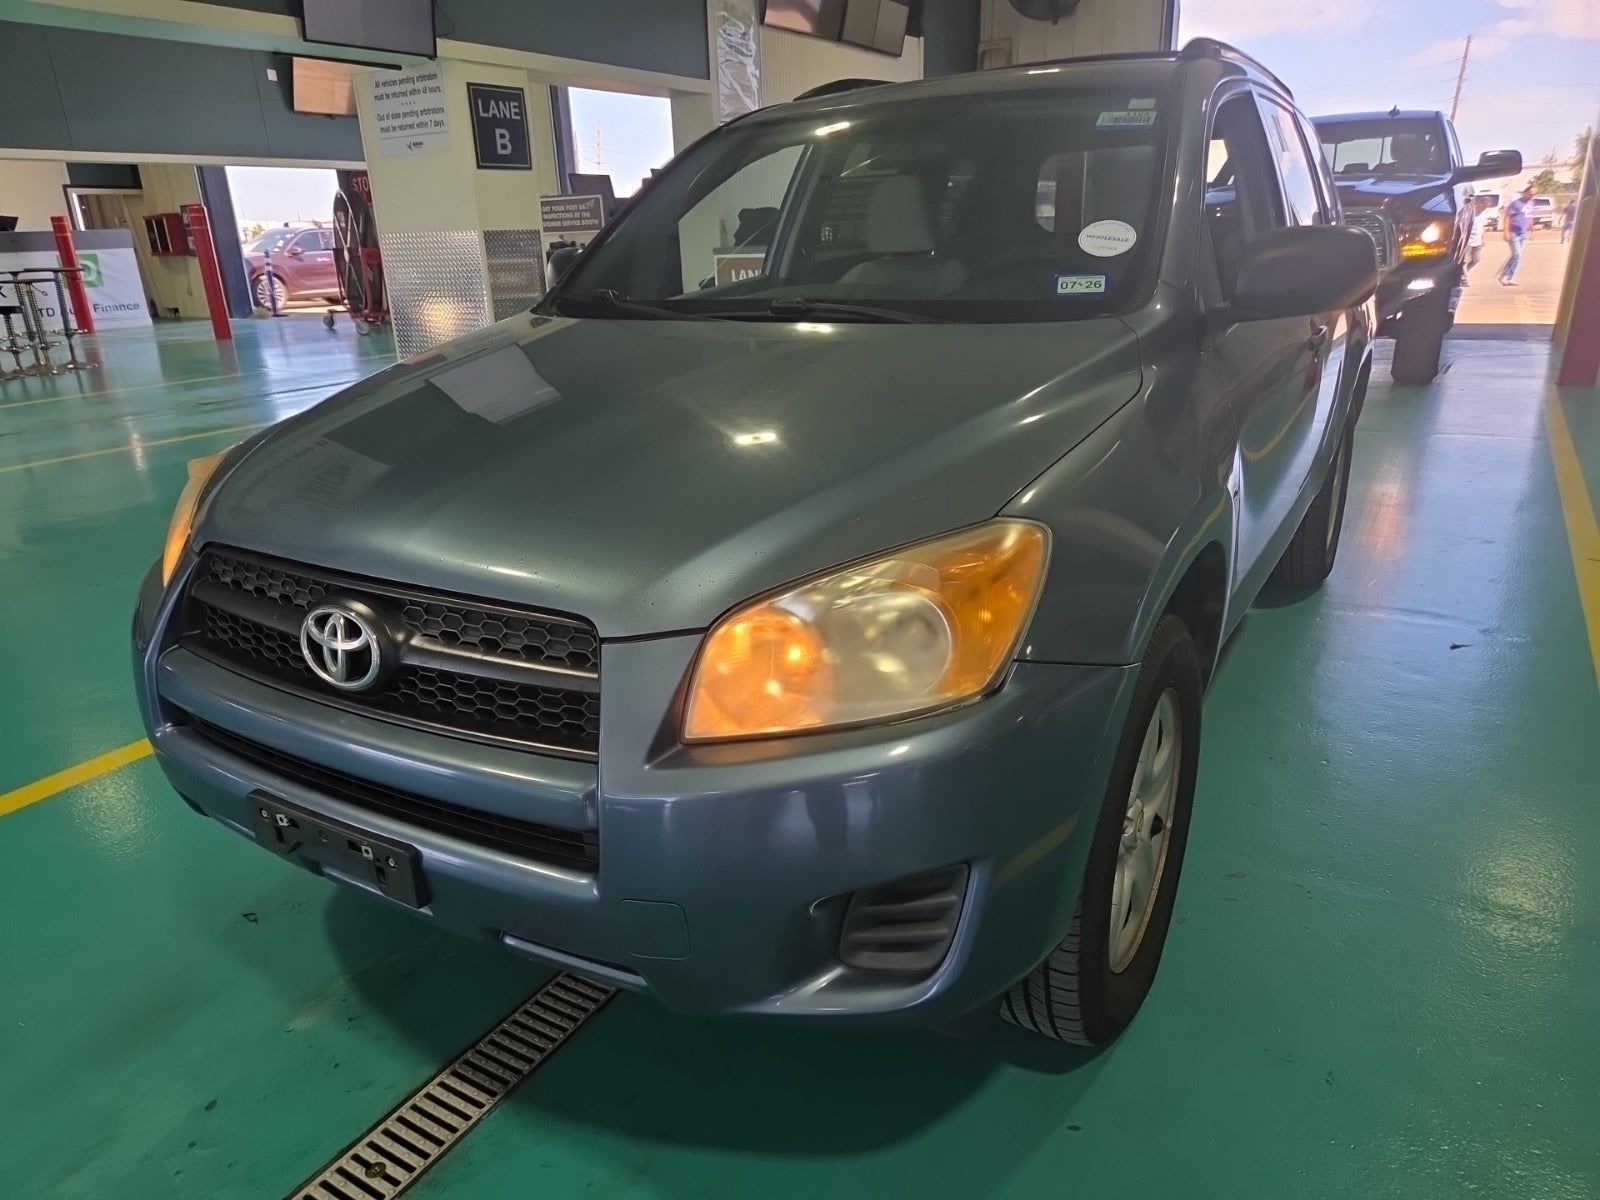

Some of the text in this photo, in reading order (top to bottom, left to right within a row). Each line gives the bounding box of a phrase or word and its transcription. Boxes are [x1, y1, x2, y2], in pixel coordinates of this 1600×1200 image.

[398, 76, 415, 87] pending
[391, 90, 408, 98] returned
[409, 88, 421, 96] within
[402, 109, 419, 118] pending
[478, 98, 521, 121] LANE
[495, 128, 512, 155] B
[352, 176, 369, 192] STO
[1086, 234, 1130, 243] WHOLESALE
[731, 269, 761, 282] LAN
[1060, 280, 1102, 290] 07 26
[39, 307, 55, 317] TD
[93, 302, 140, 313] Finance
